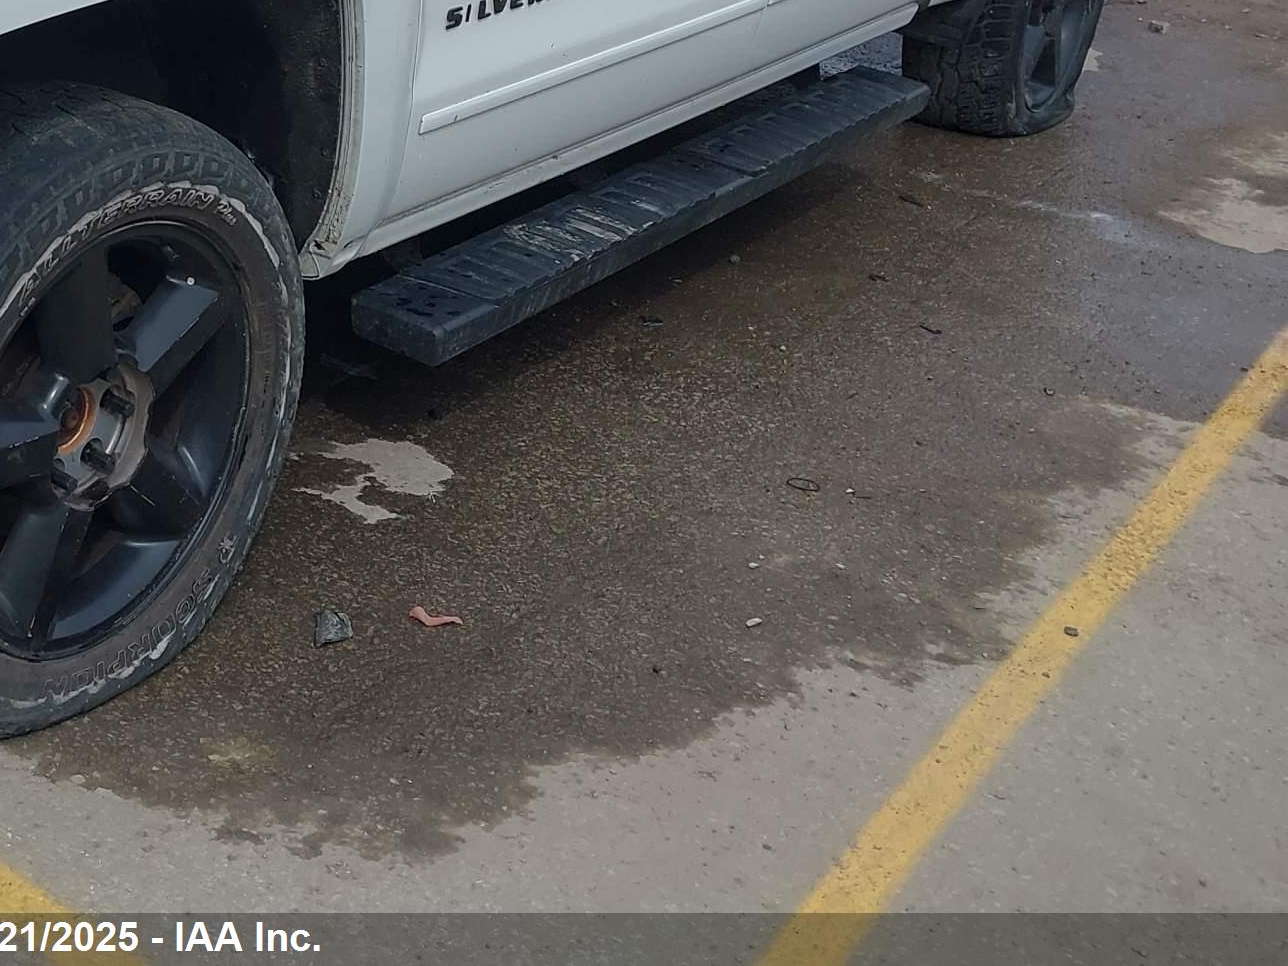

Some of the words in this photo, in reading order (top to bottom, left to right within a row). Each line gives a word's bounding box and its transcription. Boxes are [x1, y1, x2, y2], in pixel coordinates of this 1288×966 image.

[17, 233, 79, 308] ALL
[79, 188, 215, 241] TERRAIN
[41, 568, 214, 699] SCORPION
